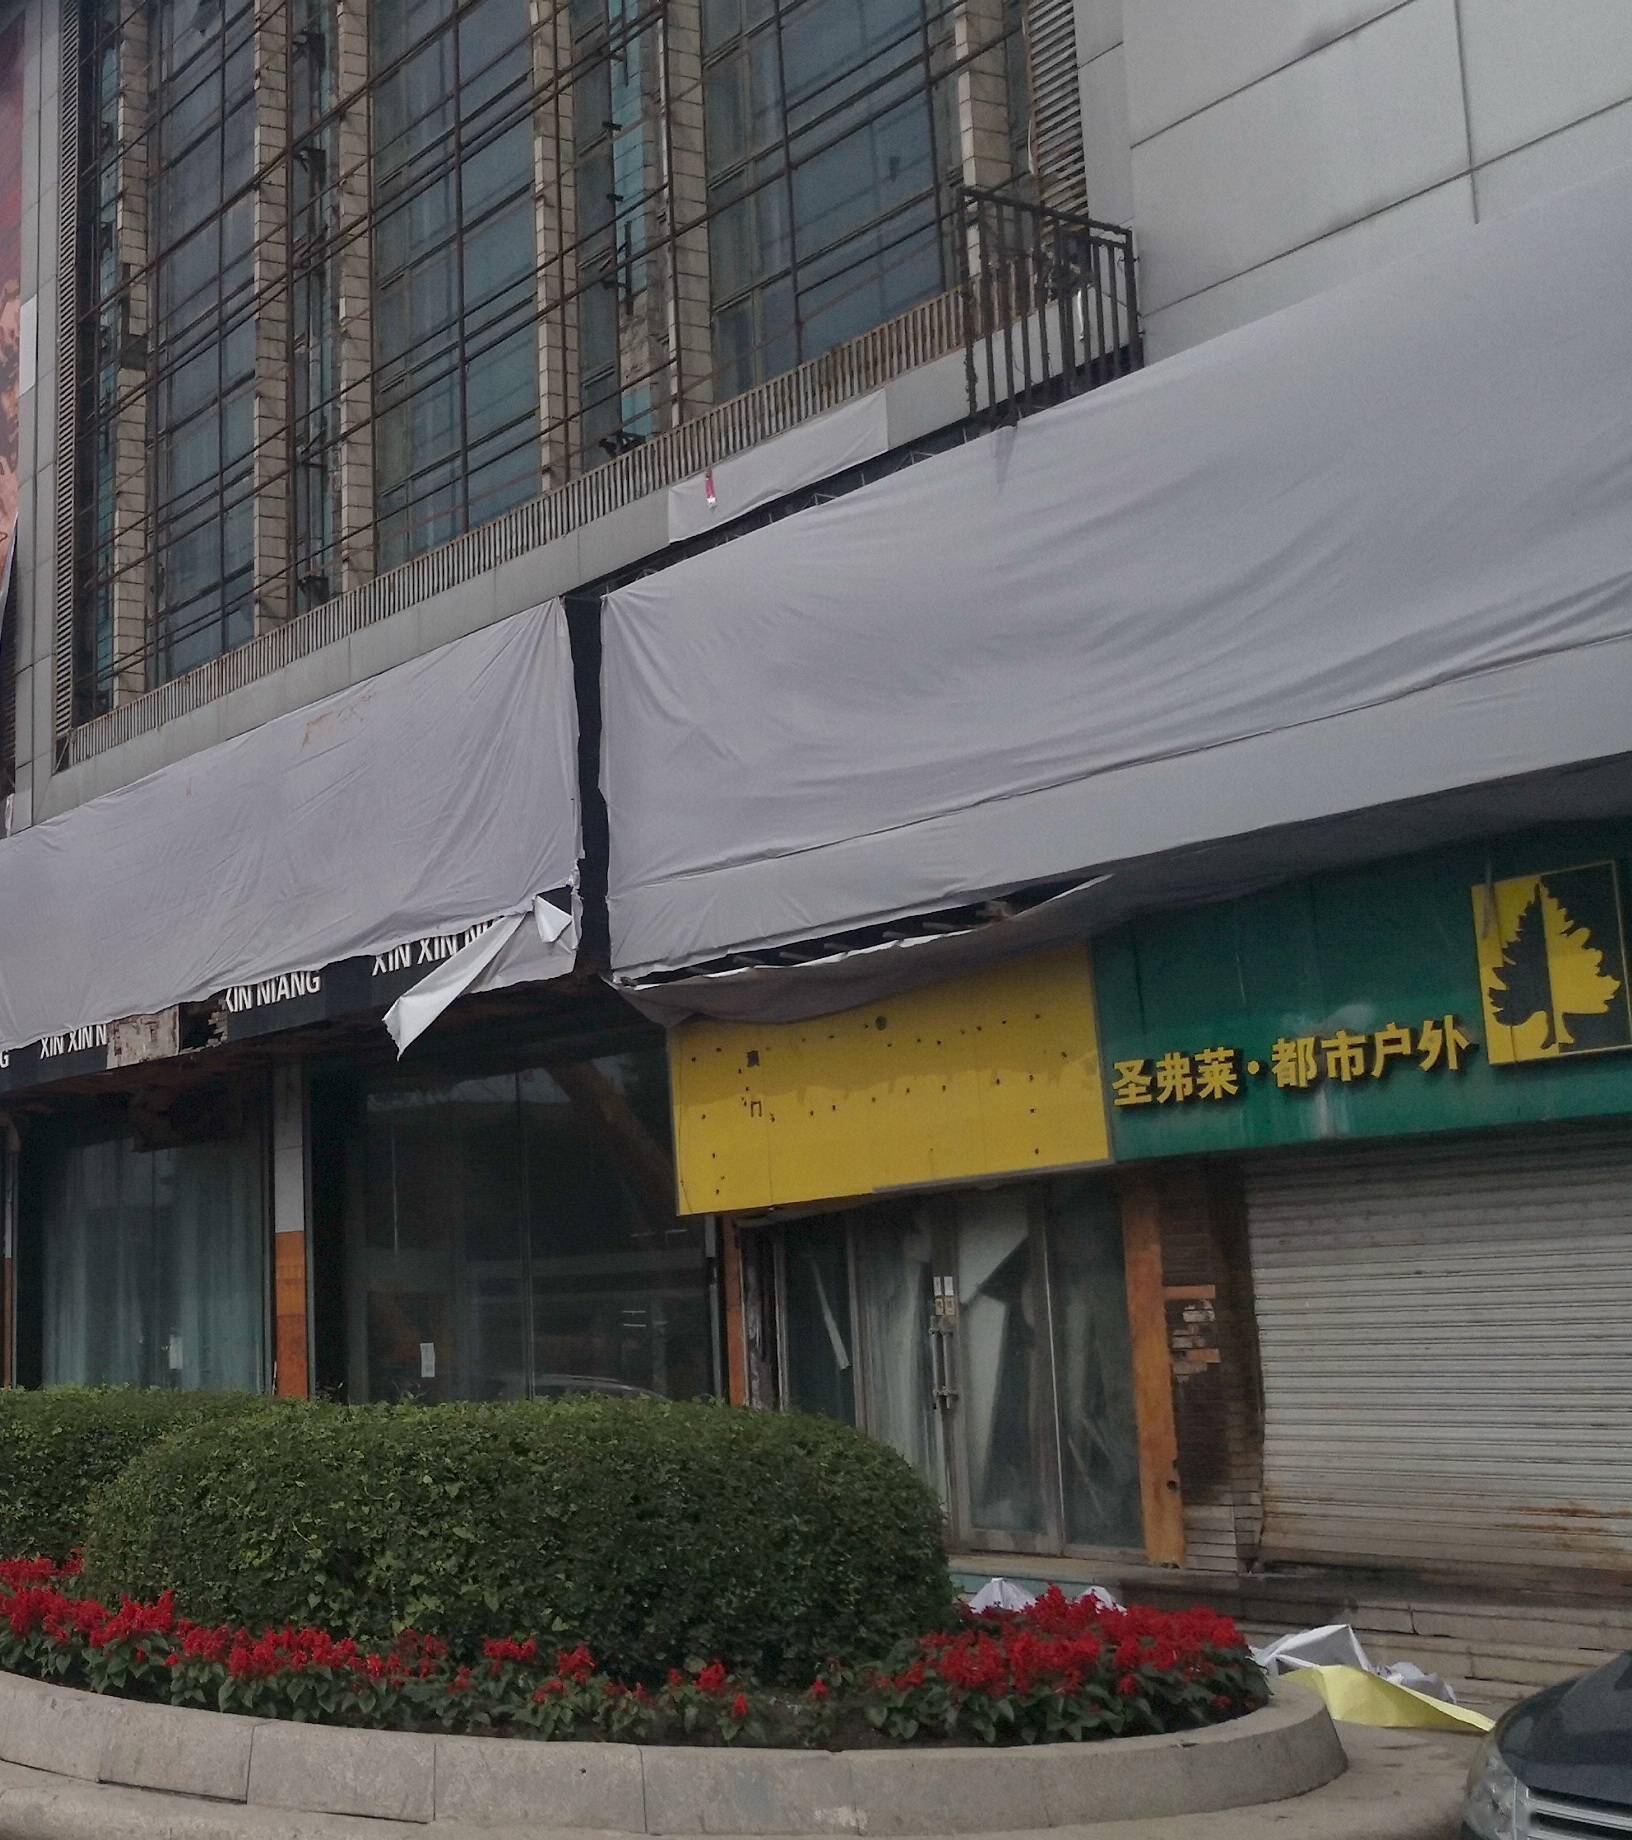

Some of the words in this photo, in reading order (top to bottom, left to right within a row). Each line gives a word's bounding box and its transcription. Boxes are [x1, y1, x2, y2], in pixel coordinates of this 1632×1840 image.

[256, 971, 321, 1007] NIANG
[40, 1035, 64, 1060] XIN
[68, 1026, 93, 1052] XIN
